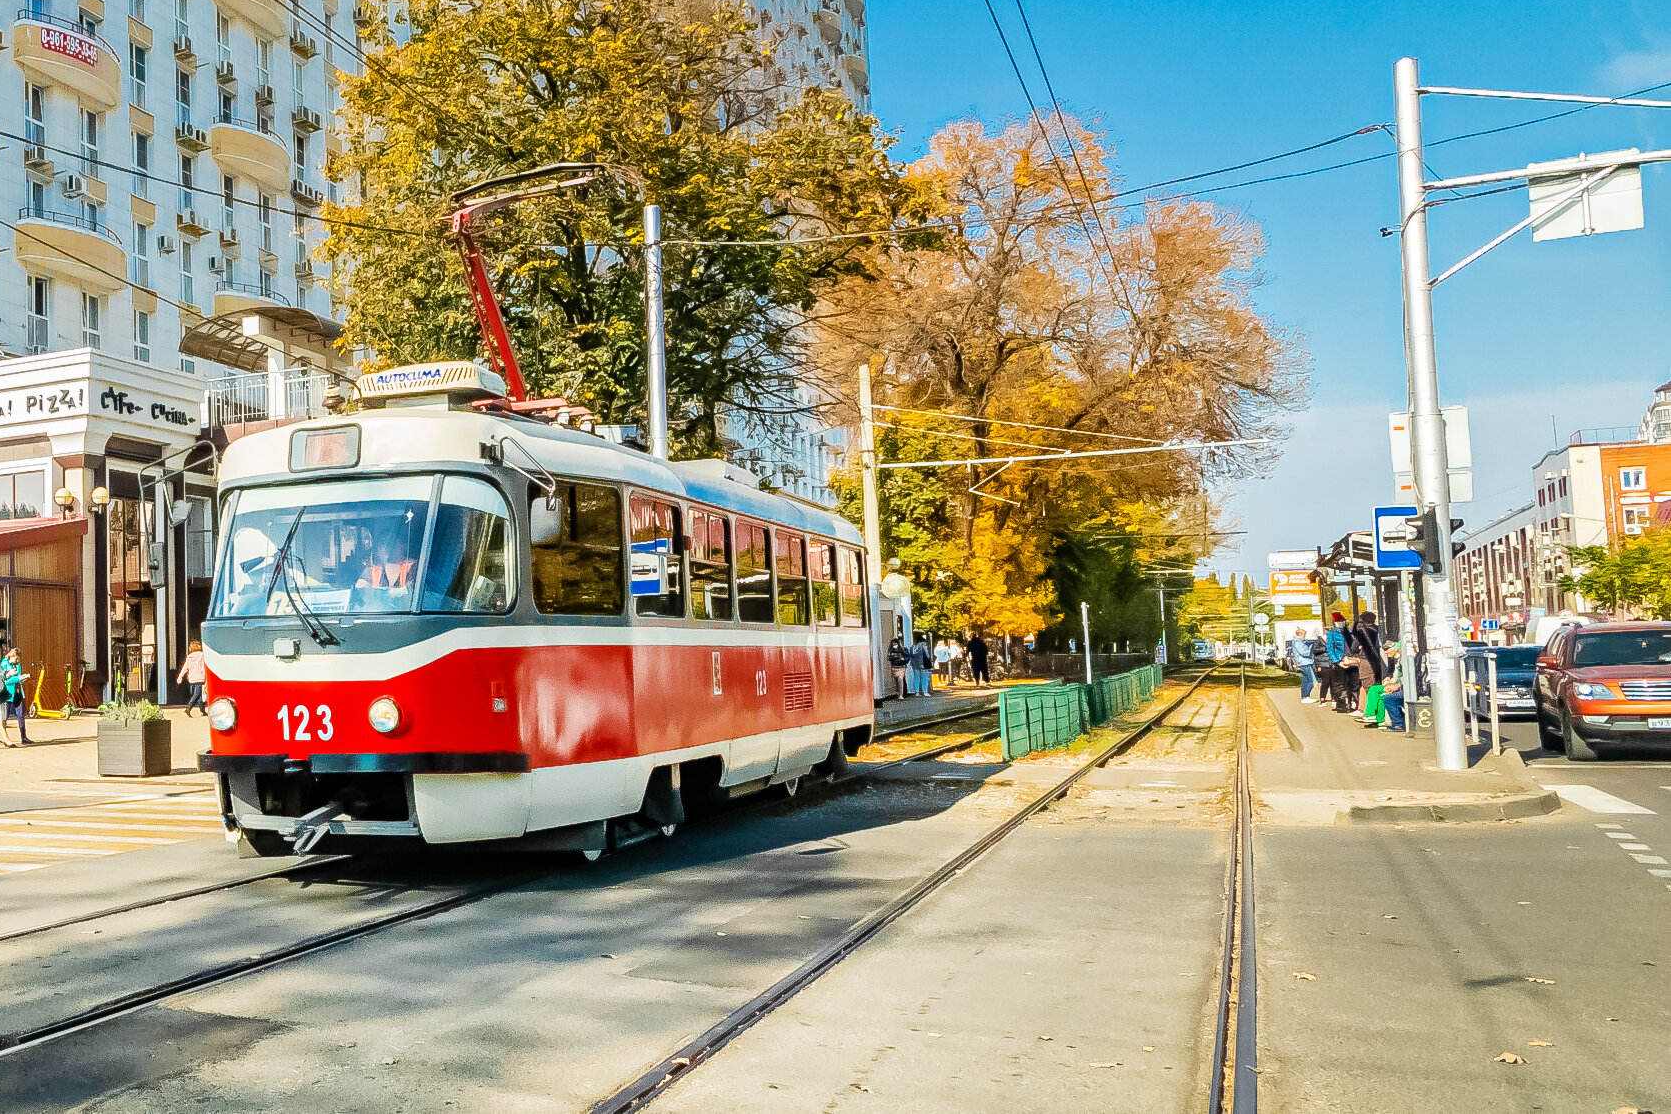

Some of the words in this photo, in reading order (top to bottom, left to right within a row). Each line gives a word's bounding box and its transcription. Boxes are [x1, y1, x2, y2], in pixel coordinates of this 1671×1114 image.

[376, 369, 441, 384] AUTOCLIMA
[755, 669, 767, 696] 123
[277, 704, 334, 742] 123
